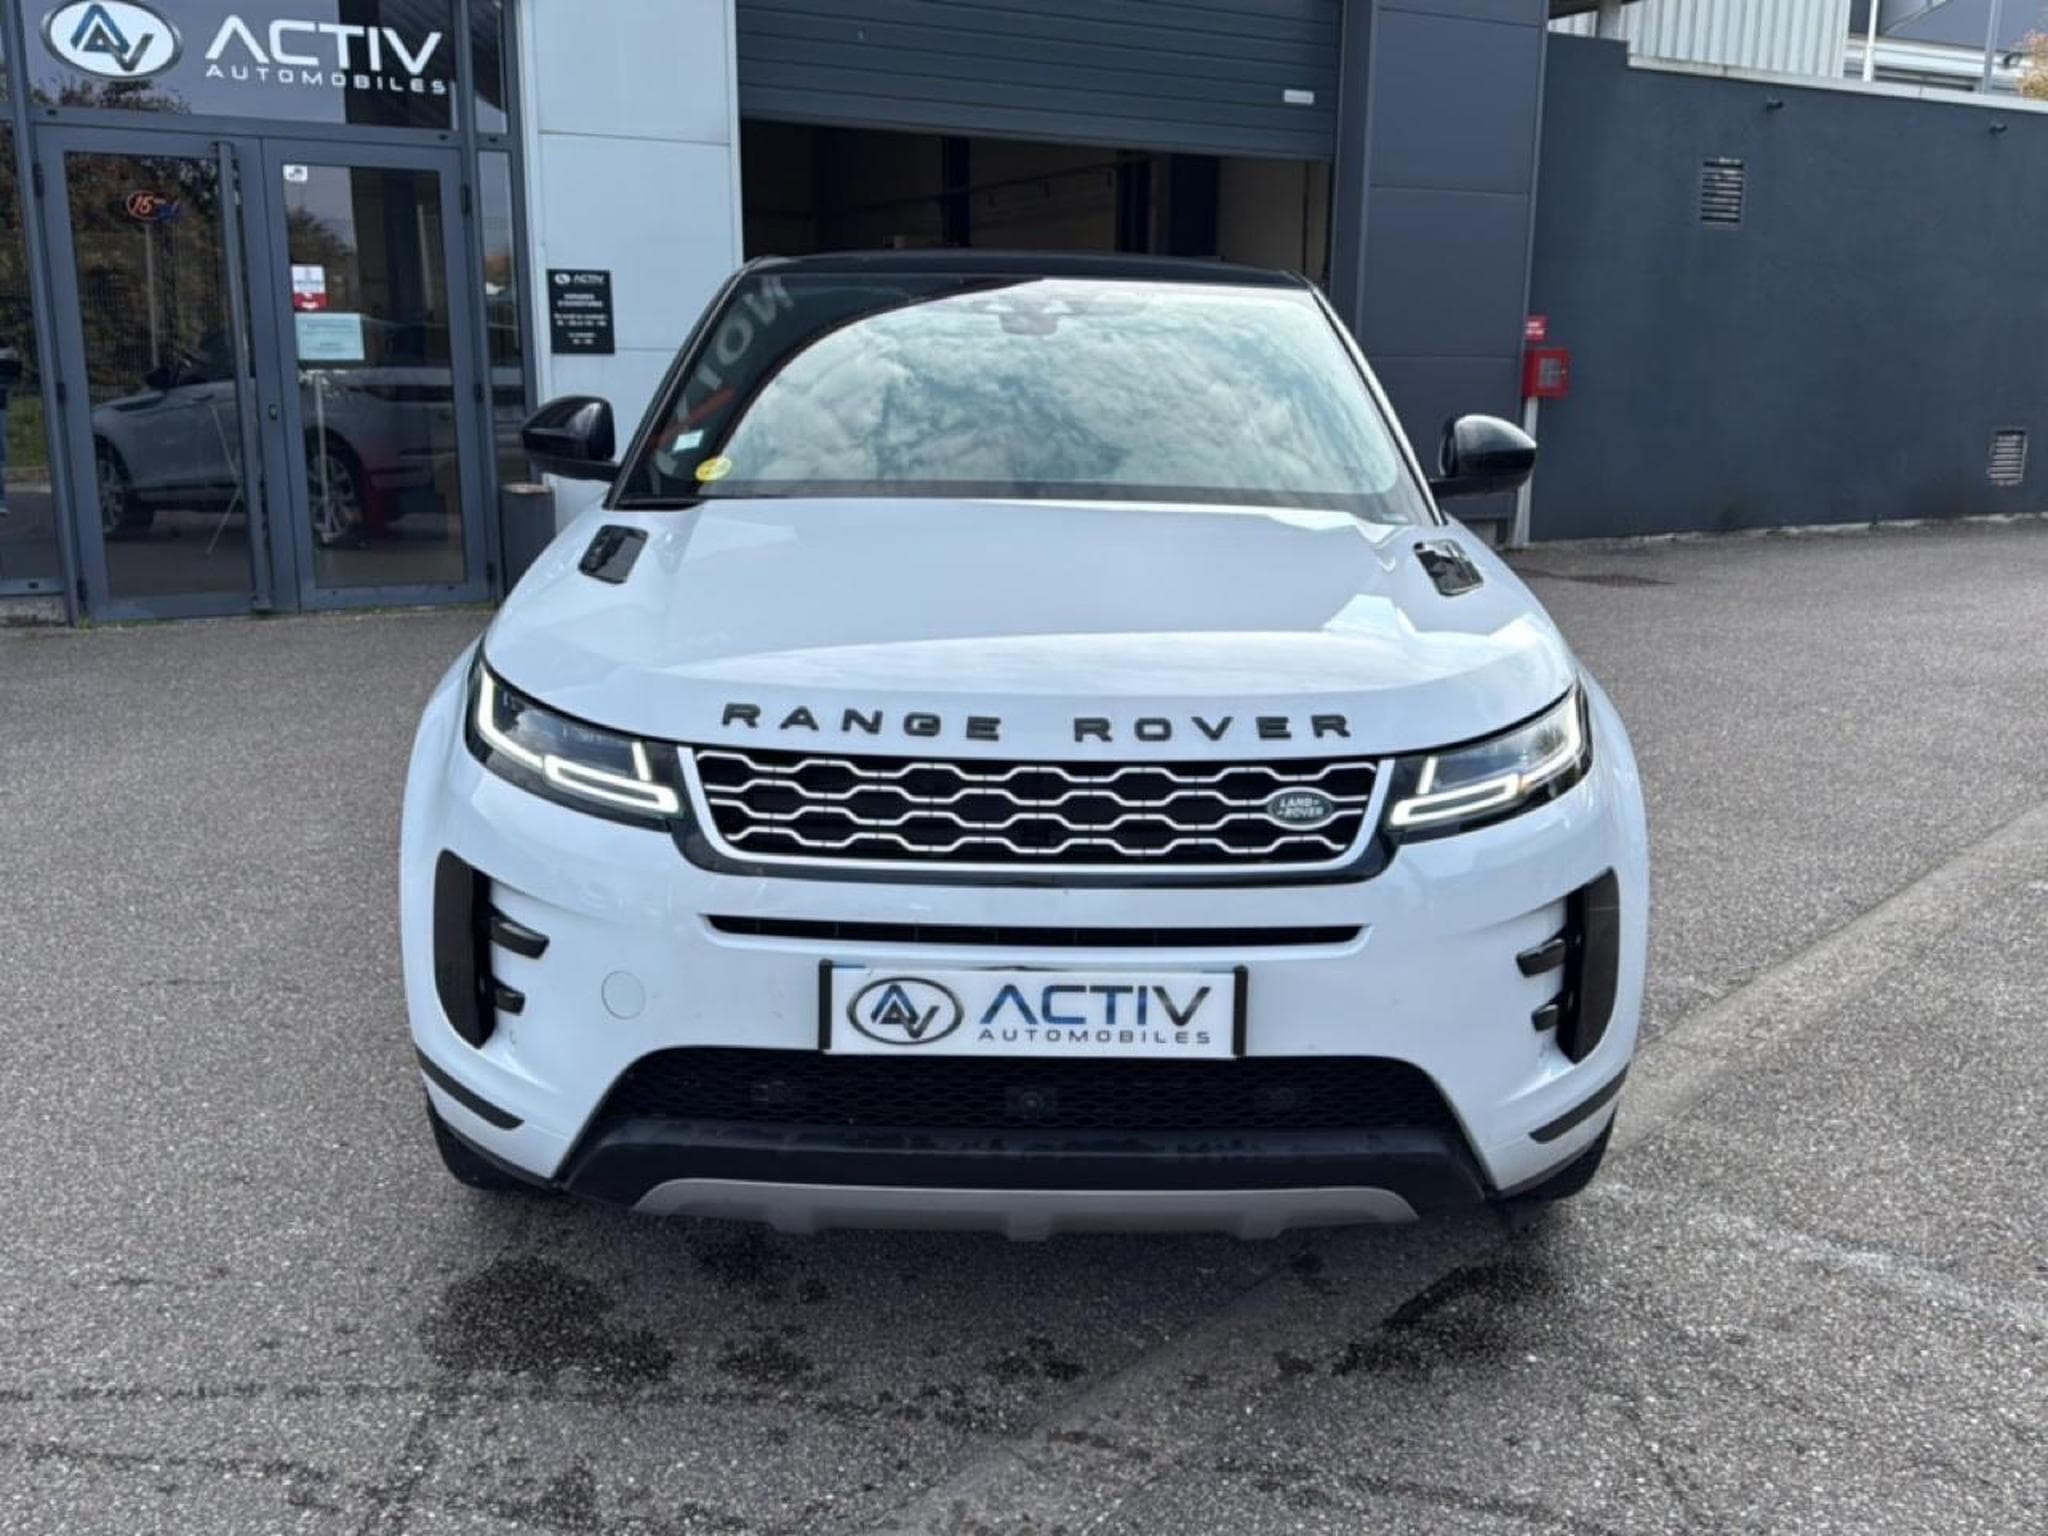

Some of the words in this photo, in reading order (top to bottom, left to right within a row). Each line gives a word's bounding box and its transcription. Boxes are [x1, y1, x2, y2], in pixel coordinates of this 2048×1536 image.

[205, 14, 442, 74] ACTIV
[205, 64, 447, 95] AUTOMOBILES
[721, 702, 1002, 742] RANGE
[1073, 714, 1352, 743] ROVER
[979, 984, 1211, 1027] ACTIV
[978, 1028, 1211, 1045] AUTOMOBILES
